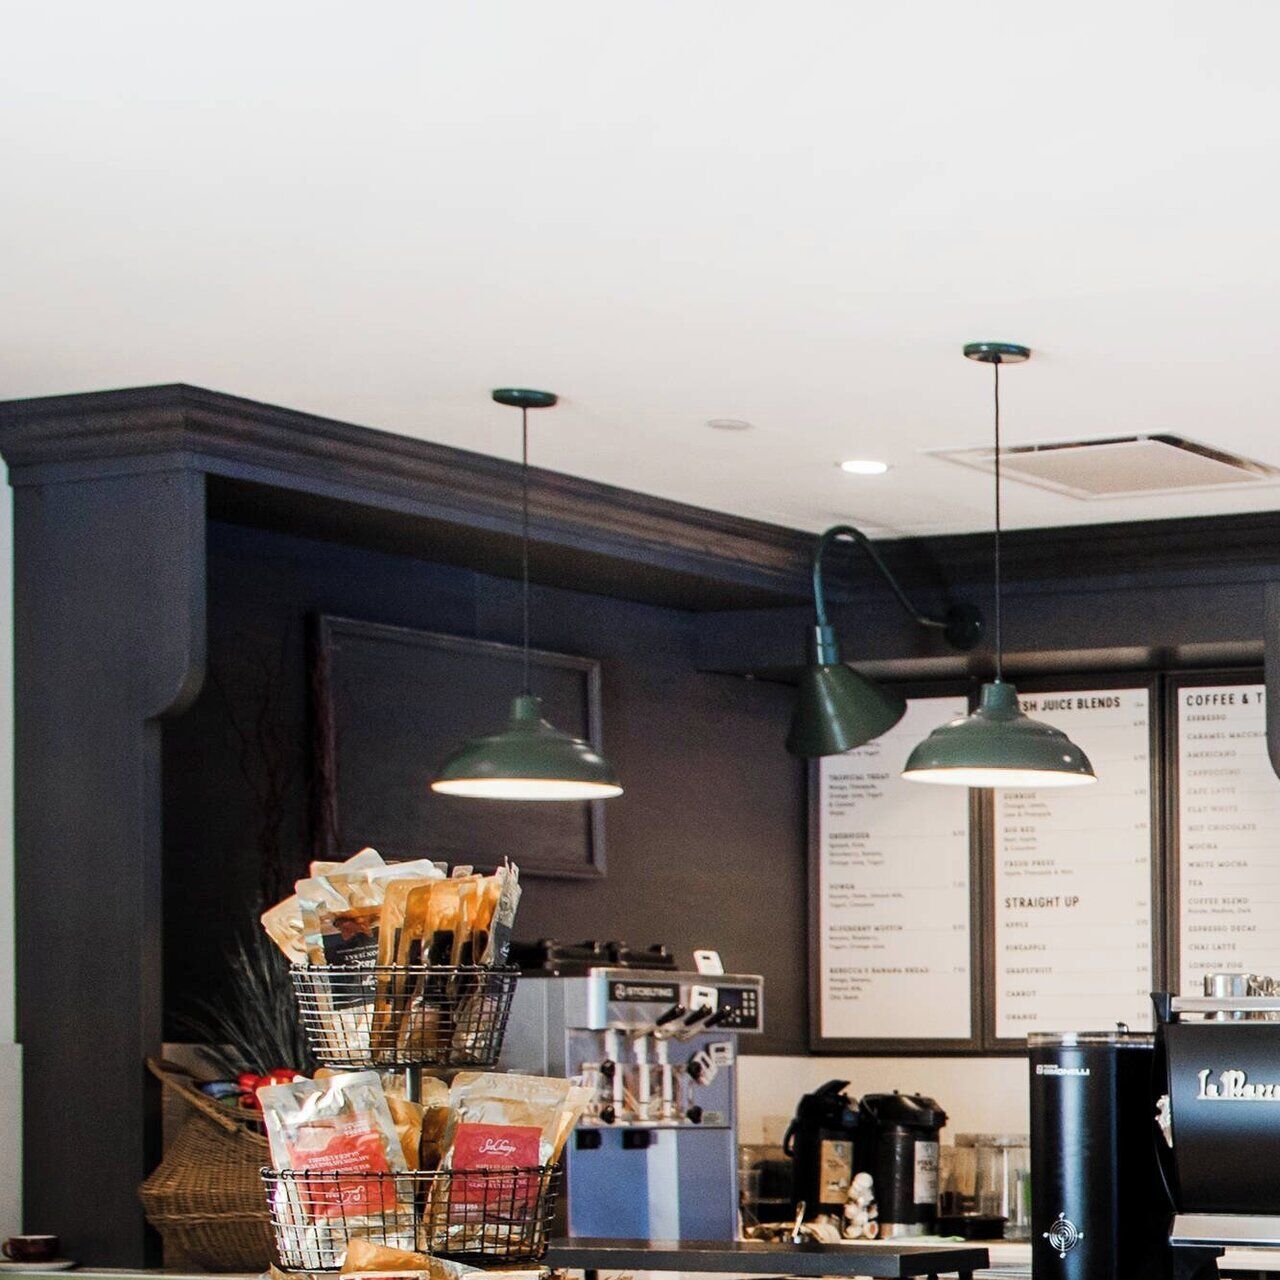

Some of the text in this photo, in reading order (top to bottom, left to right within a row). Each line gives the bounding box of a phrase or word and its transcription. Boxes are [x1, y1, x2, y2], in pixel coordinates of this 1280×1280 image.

[1041, 697, 1120, 711] JUICE BLENDS
[1187, 693, 1248, 706] COFFEE &
[1005, 896, 1079, 908] STRAIGHT UP
[1197, 1069, 1220, 1100] La
